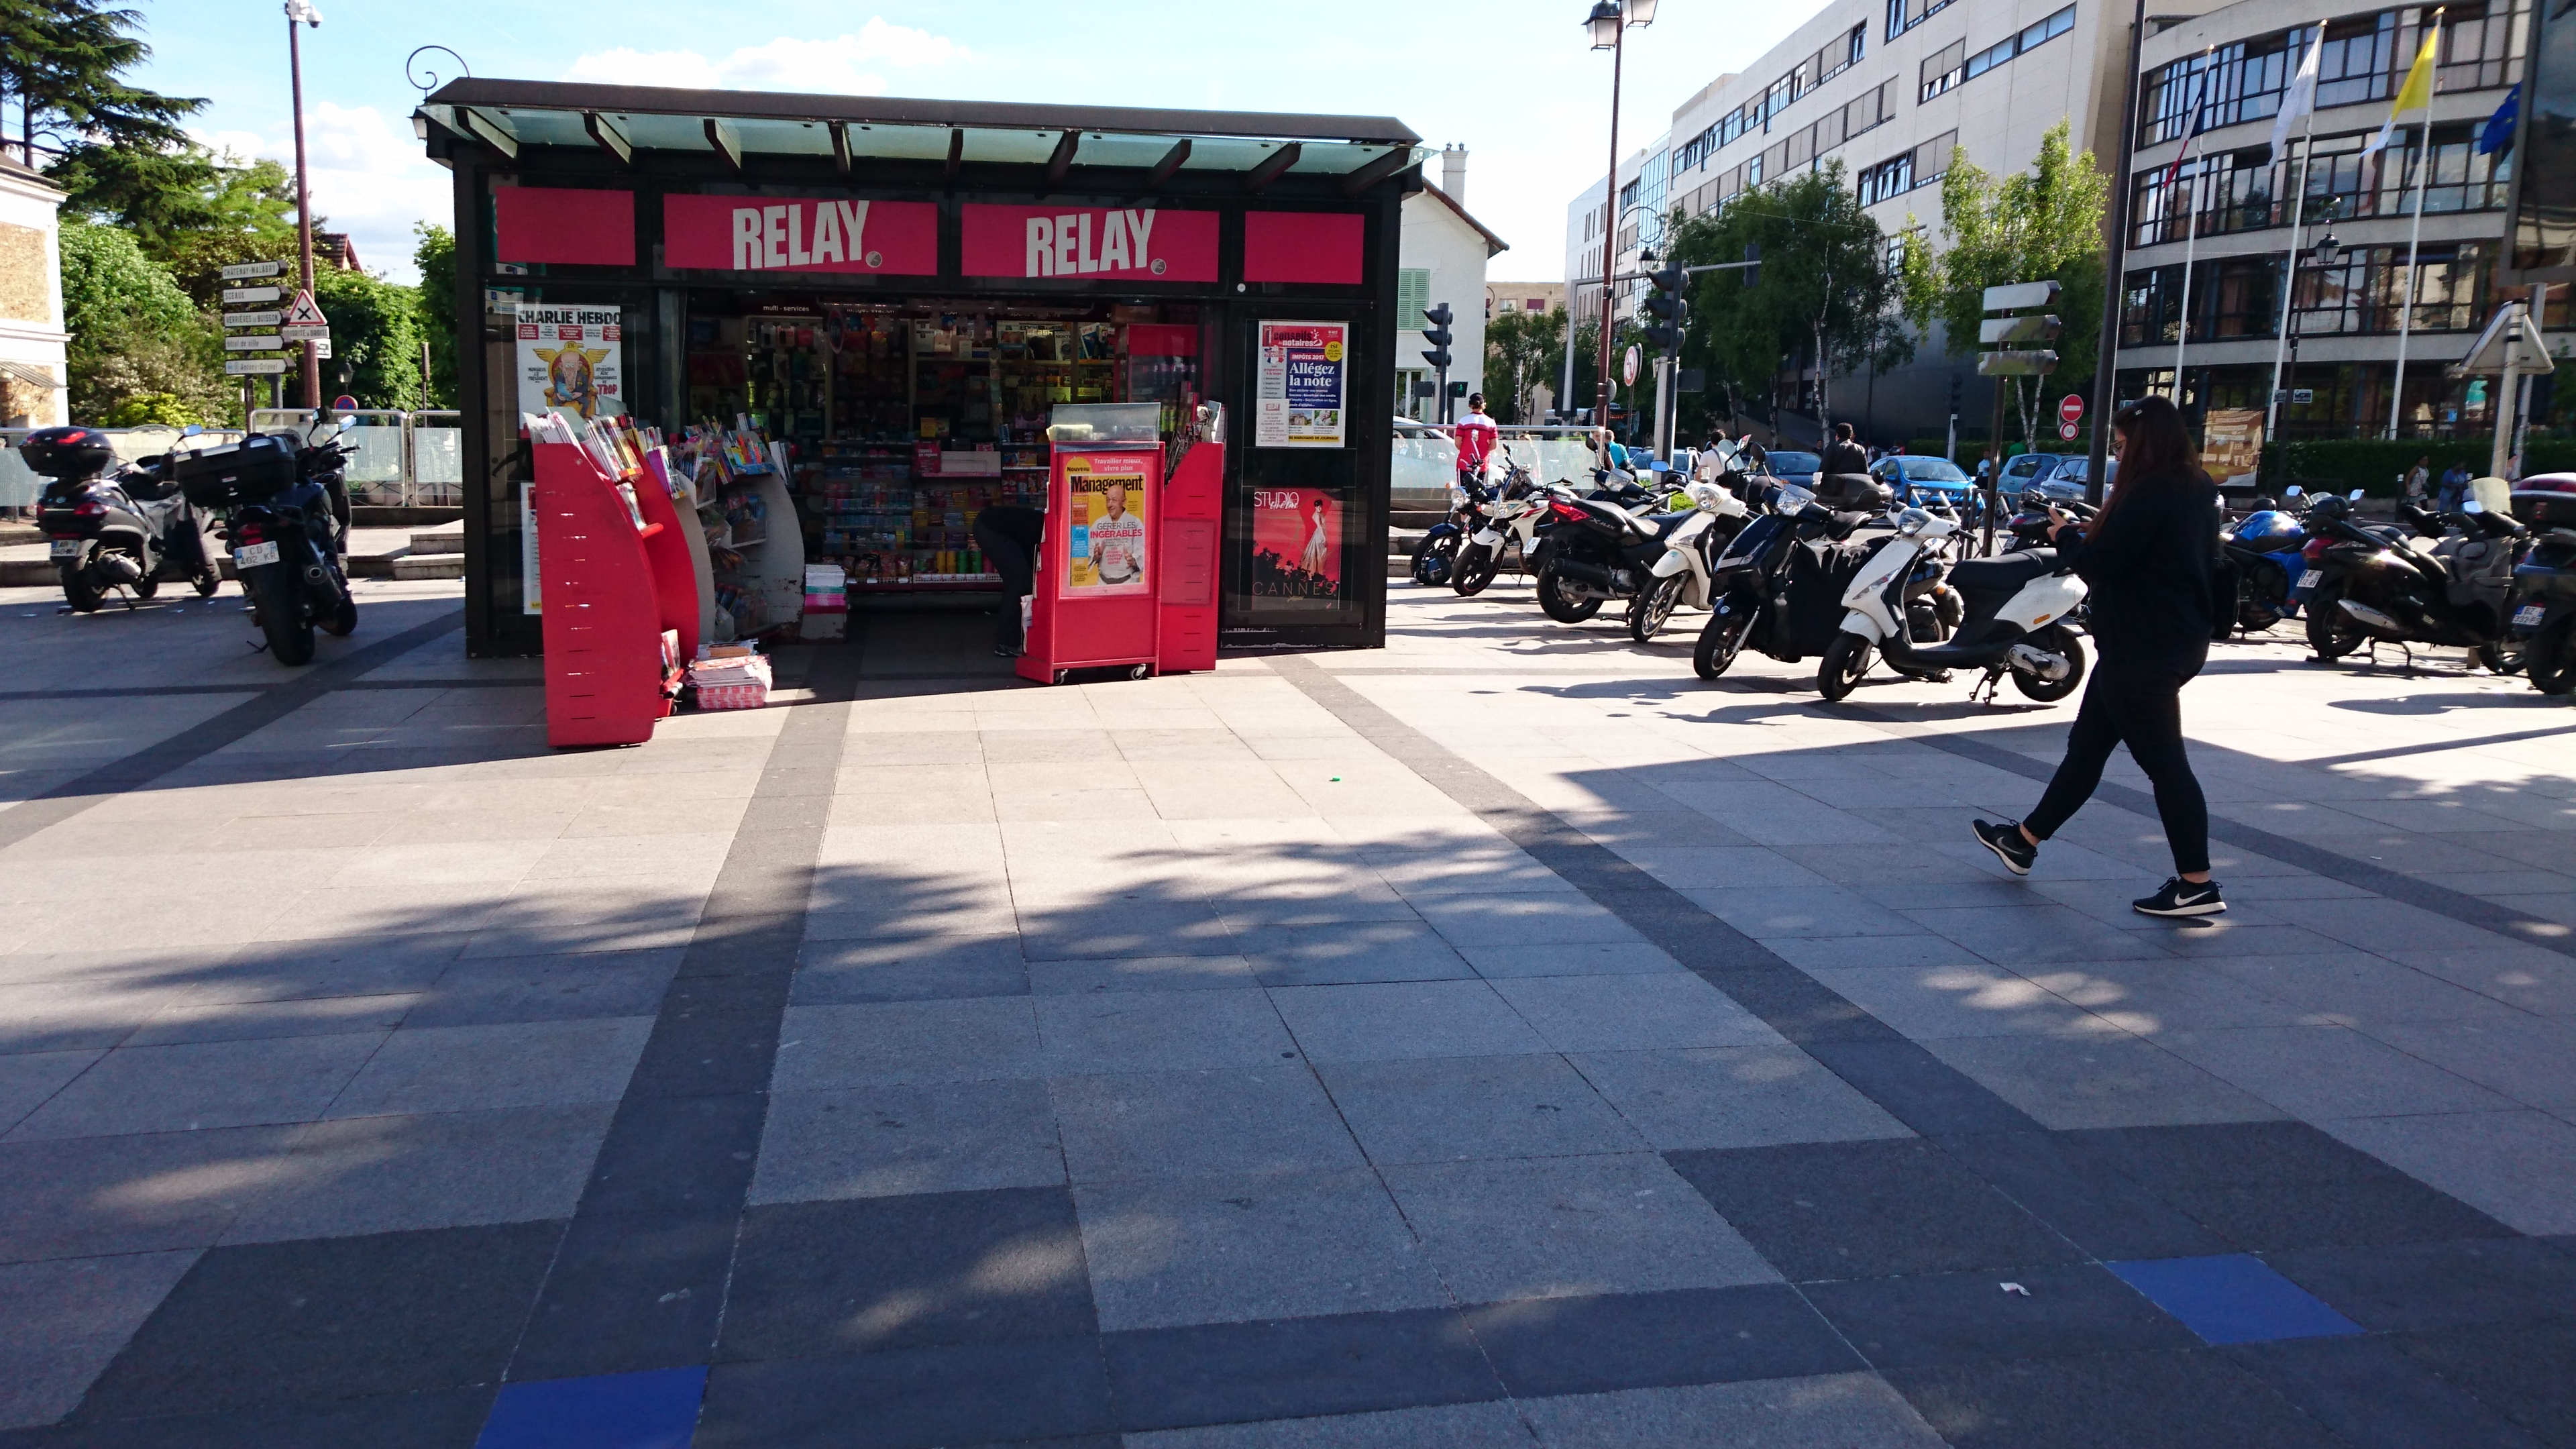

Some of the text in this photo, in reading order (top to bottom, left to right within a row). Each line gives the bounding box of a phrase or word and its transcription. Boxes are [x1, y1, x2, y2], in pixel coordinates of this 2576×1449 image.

[733, 200, 870, 270] RELAY
[1026, 209, 1156, 278] RELAY
[225, 291, 245, 300] SCEAUX
[258, 313, 278, 323] BUISSON
[518, 310, 621, 325] CHARLIE HEBDO
[310, 329, 327, 337] DROITE
[1273, 331, 1312, 341] conseils
[248, 339, 259, 347] ville
[1289, 362, 1335, 377] Allégez
[1289, 374, 1332, 386] la note
[597, 384, 618, 395] TROP
[1071, 475, 1144, 495] Management
[1254, 491, 1299, 507] STUDIO
[1097, 521, 1136, 530] GÉRER LES
[1090, 528, 1143, 539] INGÉRABLES
[250, 546, 262, 555] CD
[1252, 581, 1334, 596] CANNES
